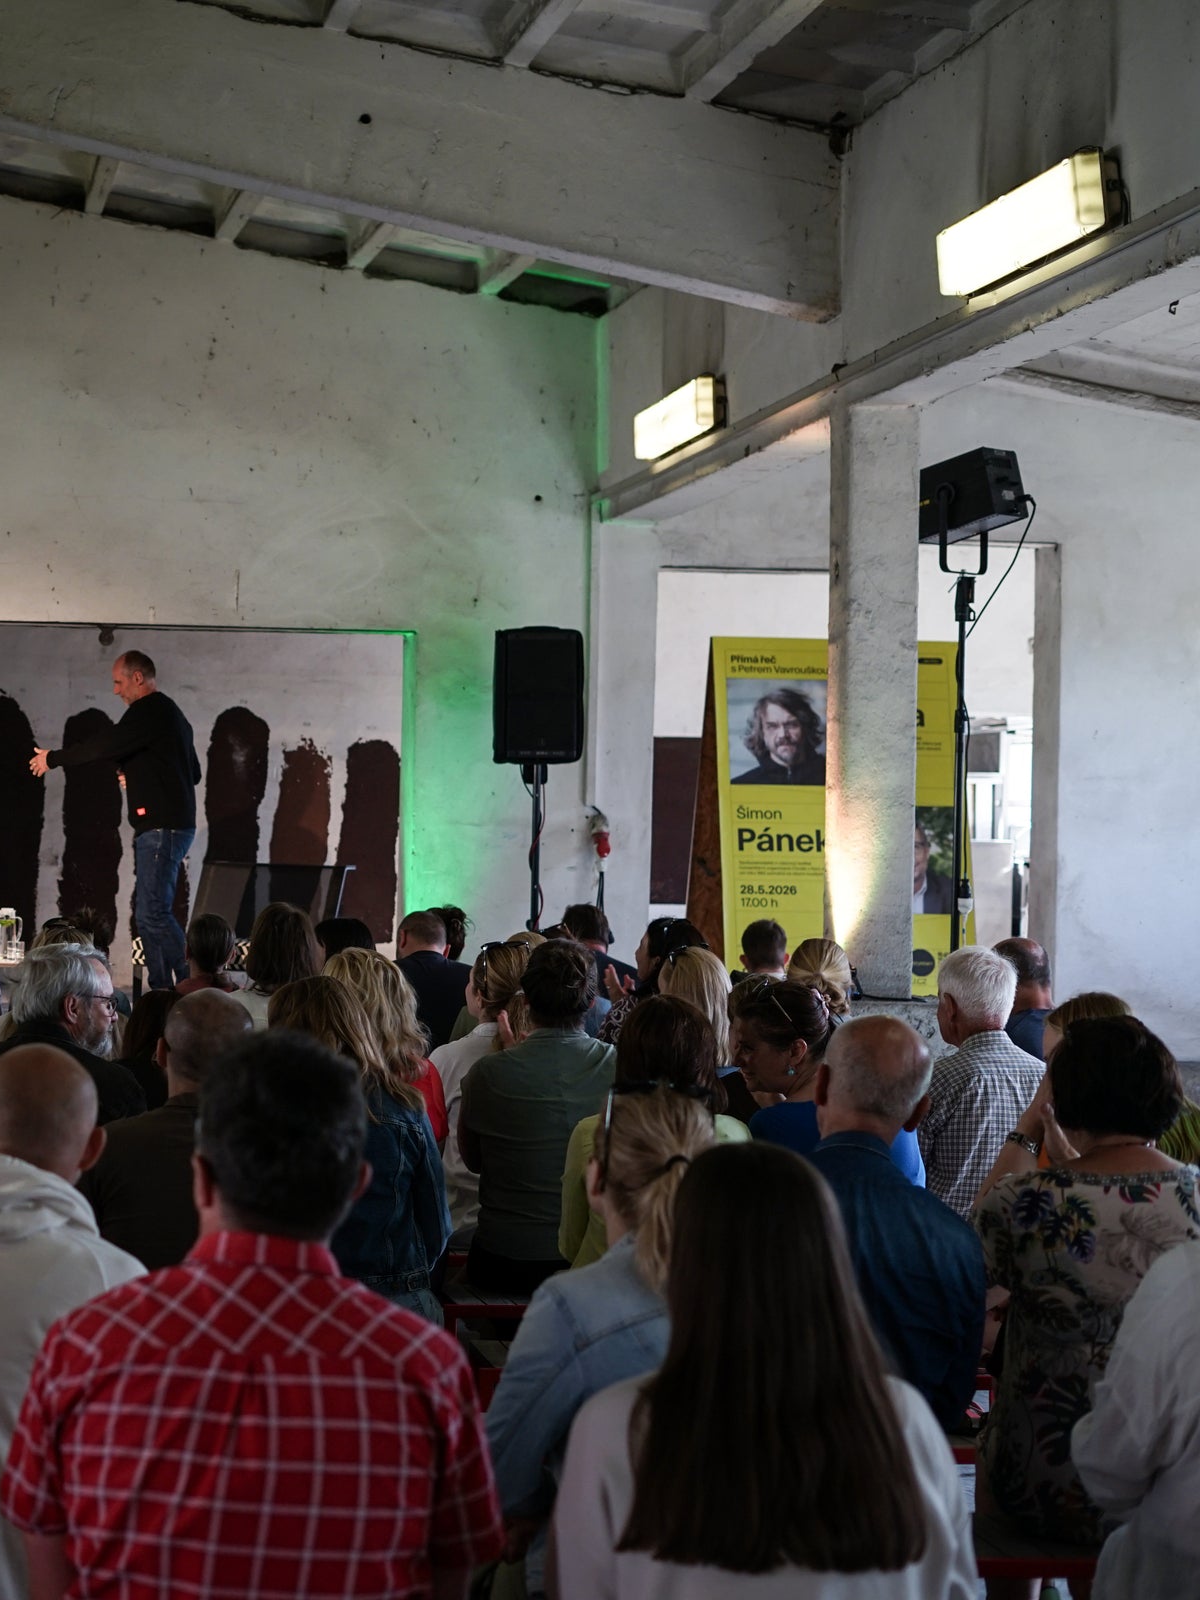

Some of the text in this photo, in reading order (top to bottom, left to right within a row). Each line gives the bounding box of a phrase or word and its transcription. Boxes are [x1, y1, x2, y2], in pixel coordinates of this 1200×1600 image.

[760, 655, 776, 664] řeč
[738, 665, 772, 673] Petrem
[736, 805, 782, 820] Šimon
[740, 885, 797, 895] 28.5.2026
[770, 898, 778, 908] h
